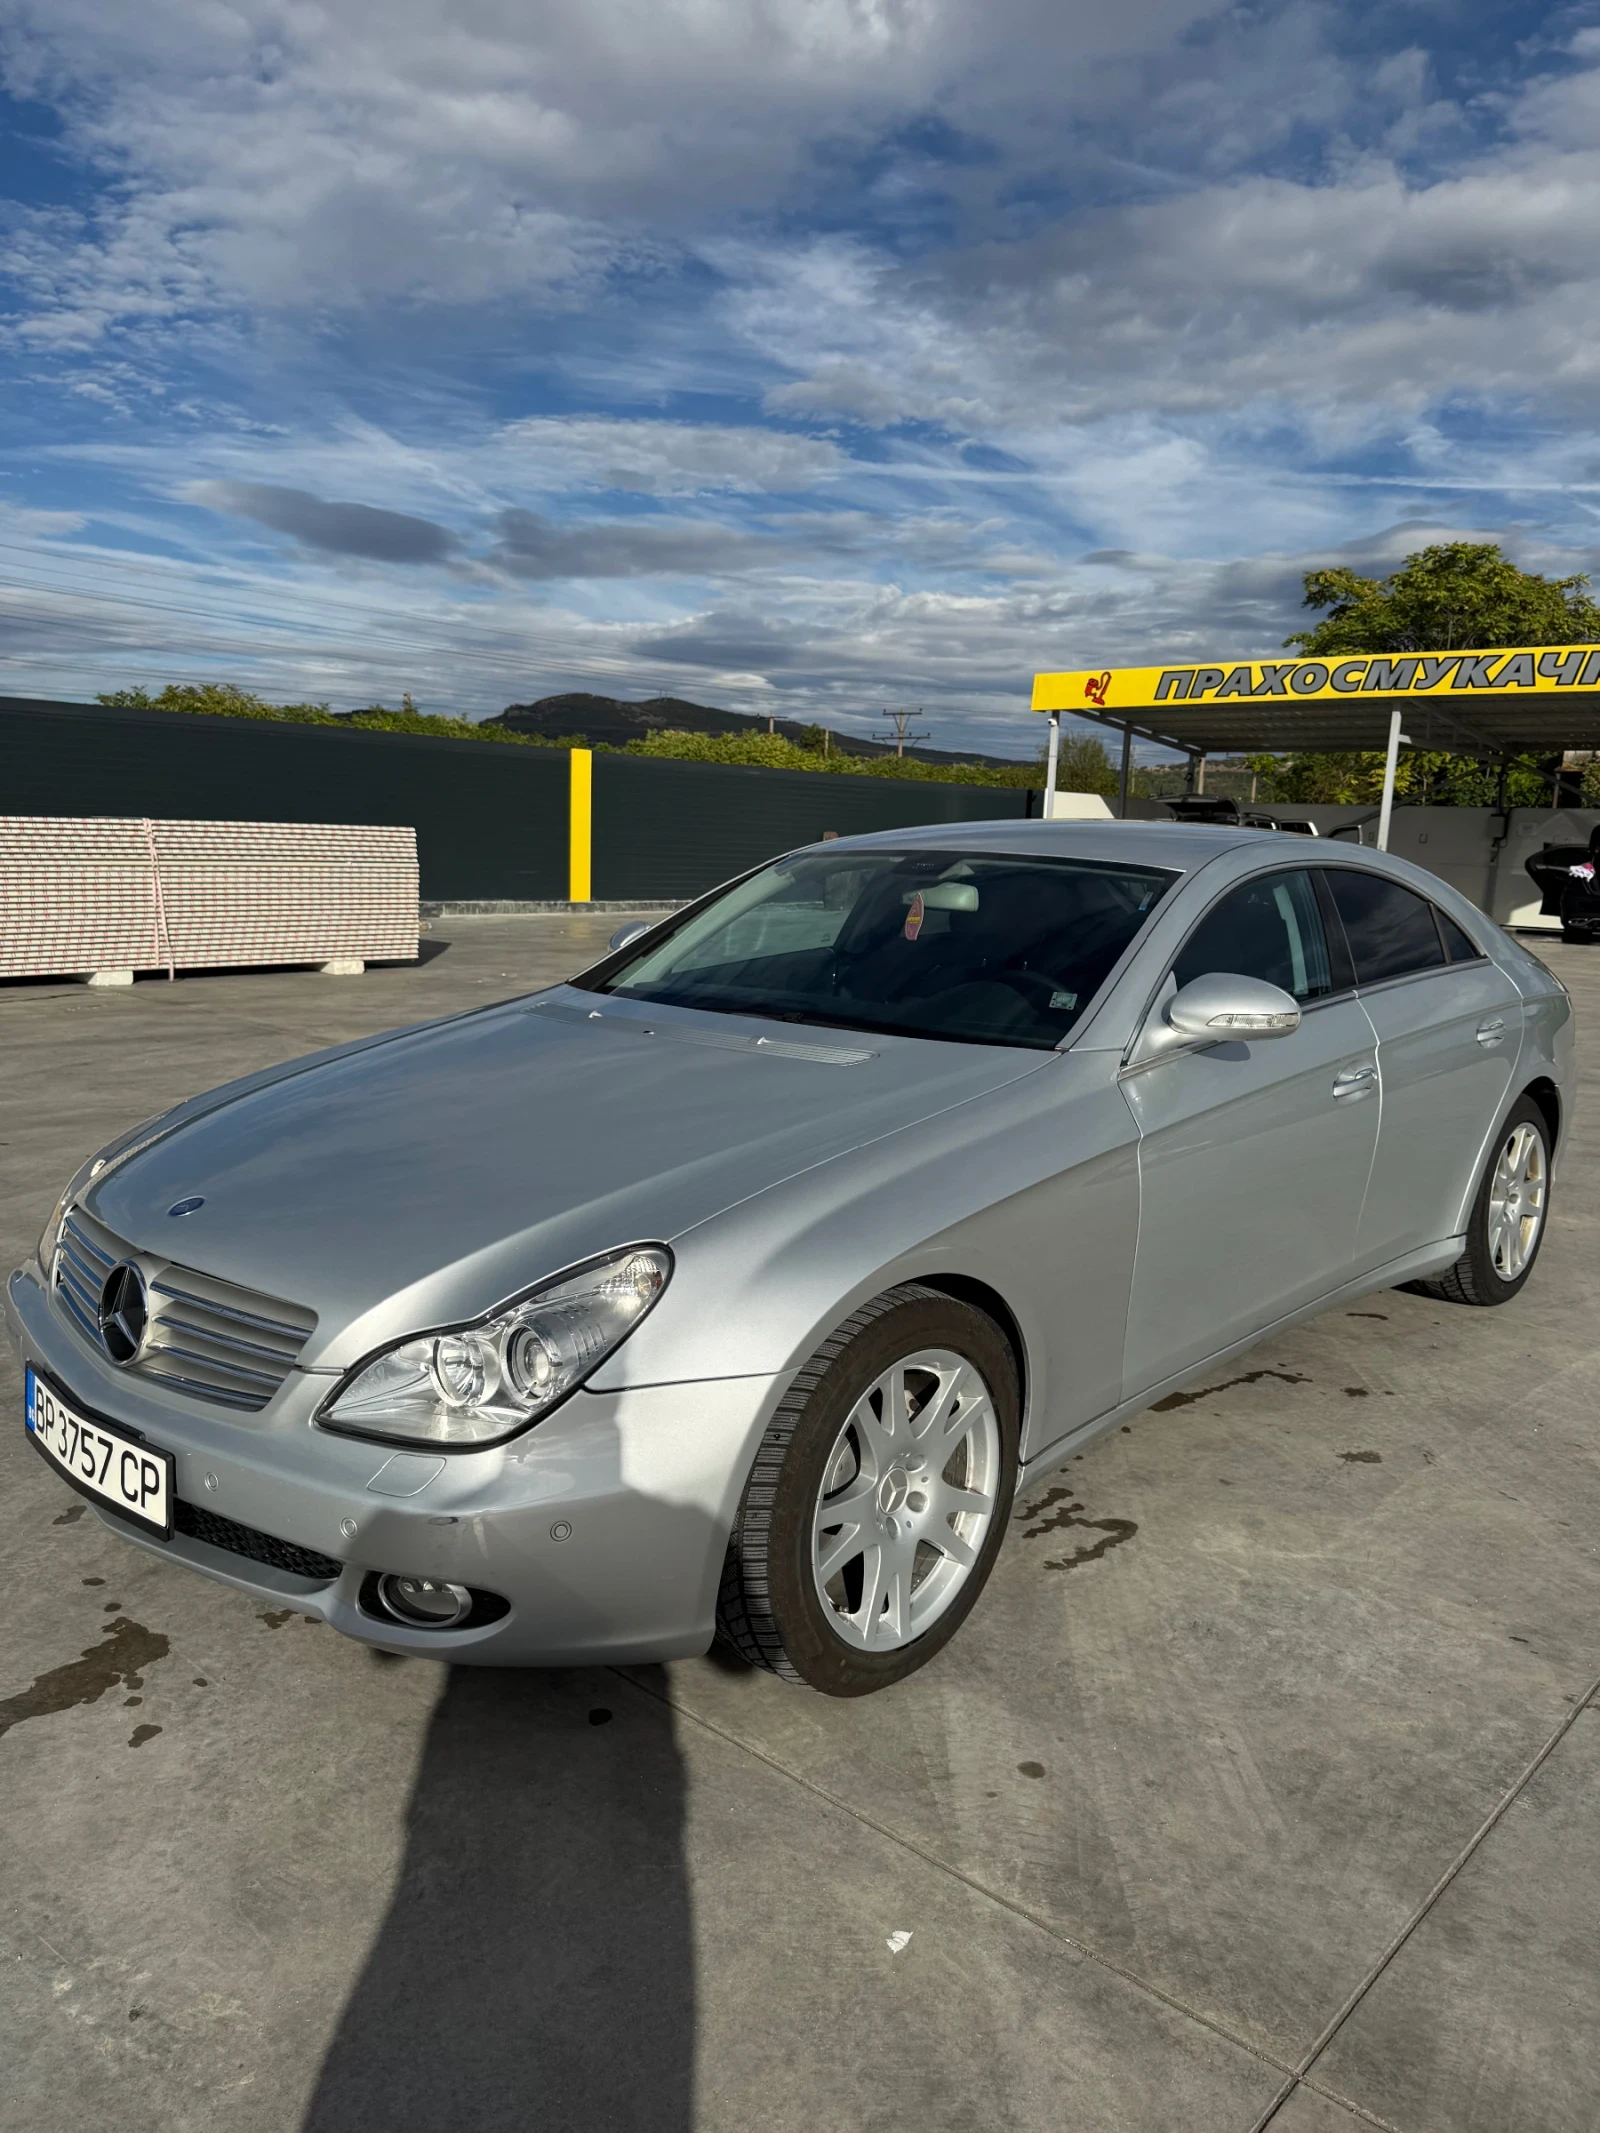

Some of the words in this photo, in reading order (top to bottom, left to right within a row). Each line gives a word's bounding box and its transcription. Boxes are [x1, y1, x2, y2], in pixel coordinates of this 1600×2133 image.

[36, 1384, 55, 1441] BP
[57, 1409, 114, 1486] 3757
[120, 1449, 160, 1509] CP
